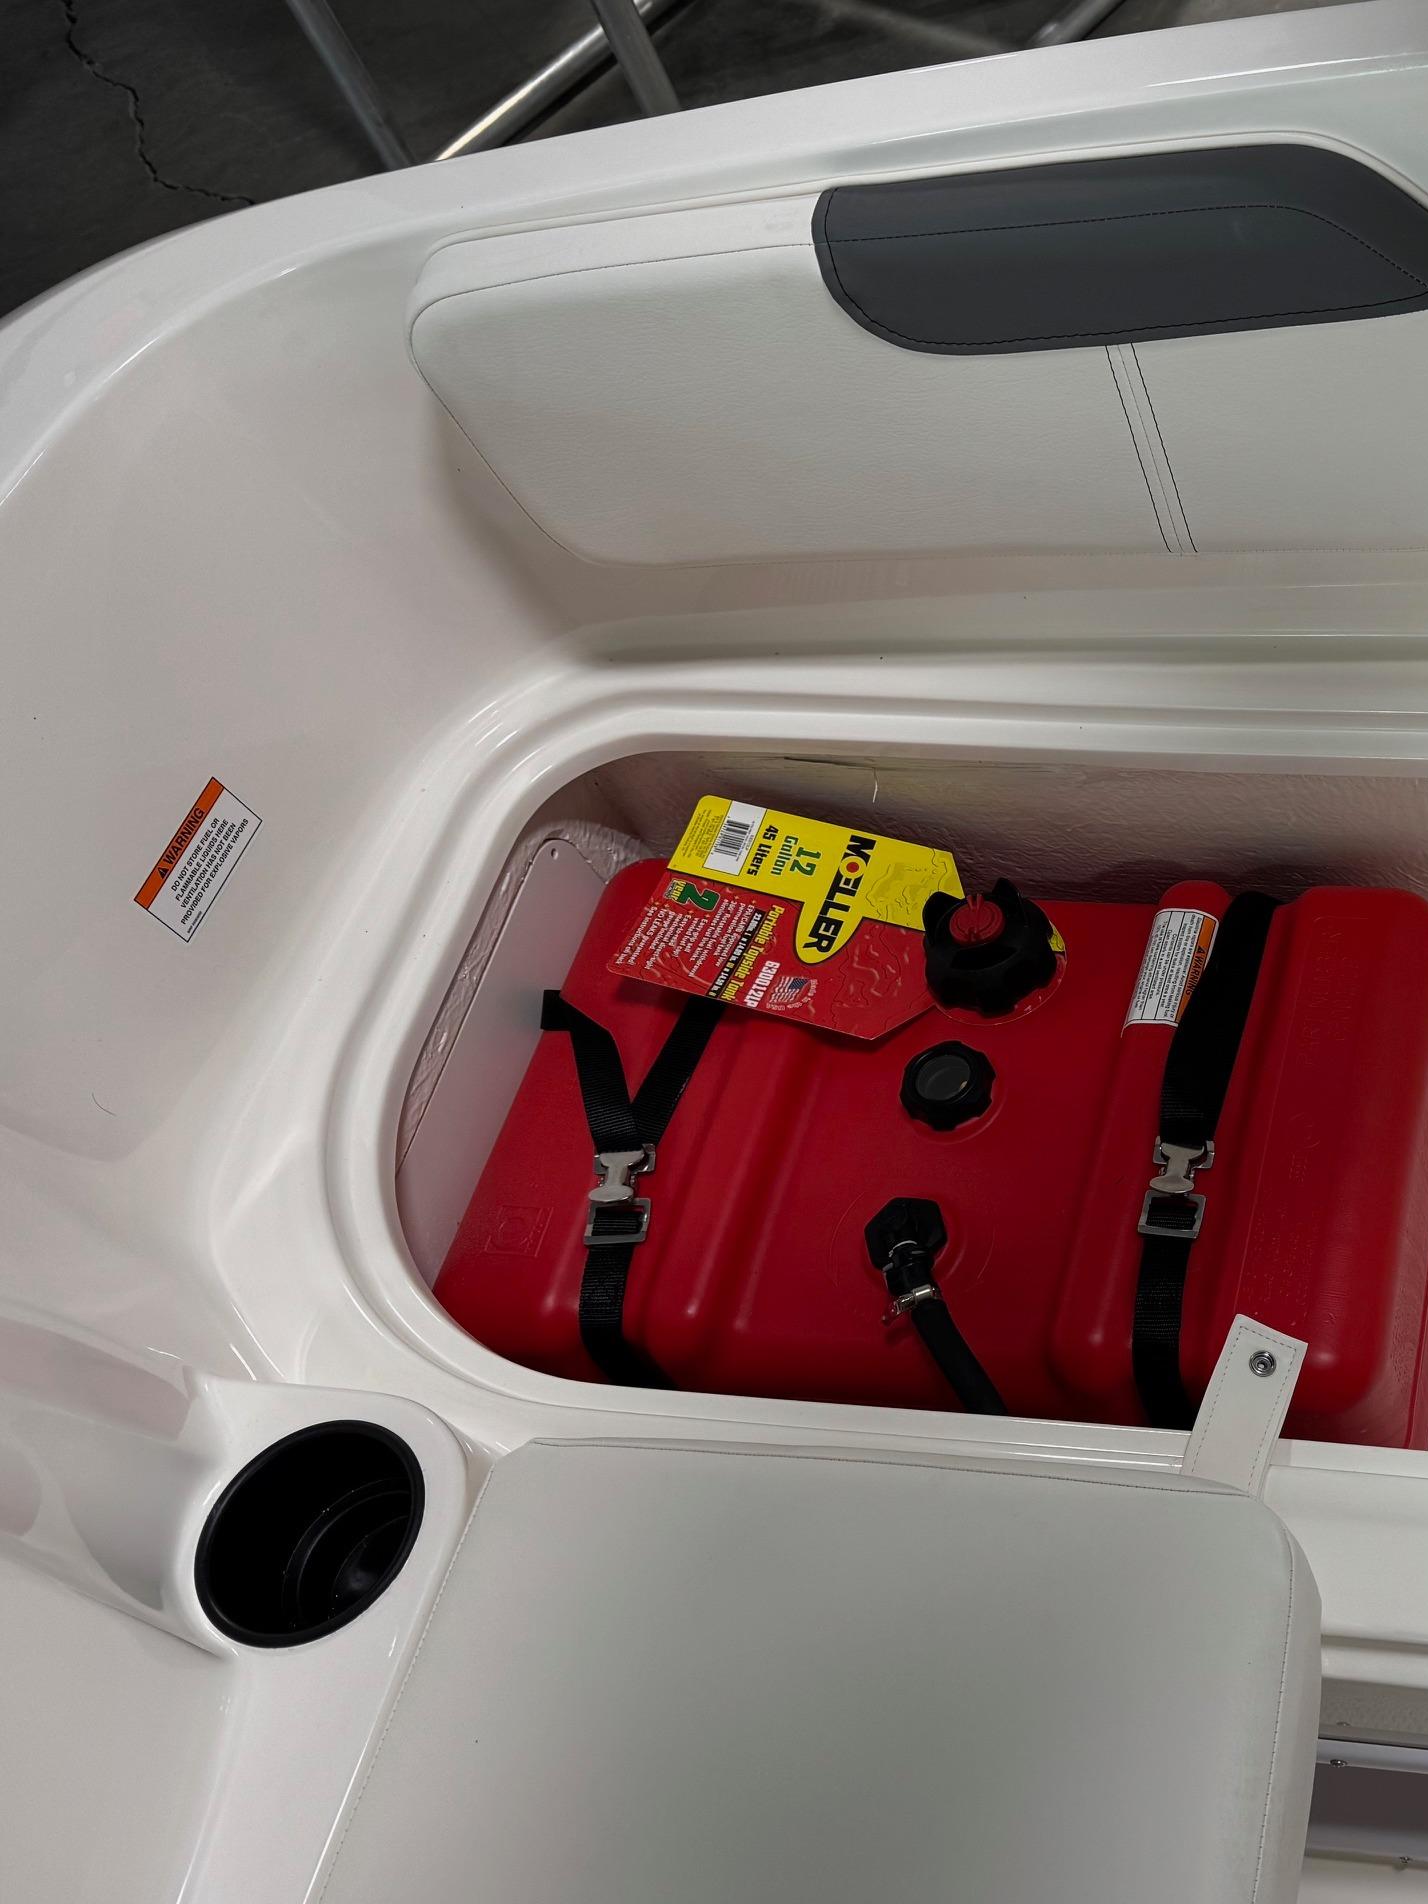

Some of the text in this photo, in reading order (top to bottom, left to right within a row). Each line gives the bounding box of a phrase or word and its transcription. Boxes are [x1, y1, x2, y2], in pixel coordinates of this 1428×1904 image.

[162, 805, 205, 866] WARNING
[761, 825, 780, 840] 45
[170, 817, 220, 892] DO NOT STORE FUEL OR
[174, 861, 202, 901] FLAMMABLE
[198, 835, 218, 863] LIQUIDS
[214, 818, 229, 838] HERE
[180, 866, 209, 909] VENTILATION
[205, 853, 217, 869] HAS
[213, 839, 226, 855] NOT
[222, 821, 237, 841] BEEN
[745, 843, 772, 876] Liters
[769, 835, 799, 875] Gallon
[788, 847, 822, 875] 12
[180, 890, 204, 925] PROVIDED
[200, 876, 213, 893] FOR
[208, 842, 233, 879] EXPLOSIVE
[229, 817, 249, 844] VAPORS
[671, 879, 687, 900] year
[680, 883, 720, 911] 2
[802, 835, 877, 953] MOELLER
[645, 905, 657, 916] See
[657, 907, 667, 916] NO
[661, 911, 676, 927] gauge
[709, 899, 730, 926] eliminates
[627, 916, 651, 946] instructions
[645, 918, 662, 936] LEAKS
[661, 913, 683, 942] mechanical
[684, 917, 700, 935] vented
[703, 926, 715, 936] fuel
[710, 912, 731, 938] Rotatable
[712, 903, 748, 956] permeation fuel tank
[678, 935, 690, 946] fuel
[697, 936, 709, 947] line
[704, 938, 716, 949] fuel
[718, 931, 740, 956] approved
[719, 904, 784, 1001] Portable Topside Tank
[614, 953, 627, 965] back
[714, 956, 725, 967] low
[1186, 955, 1206, 996] WARNING
